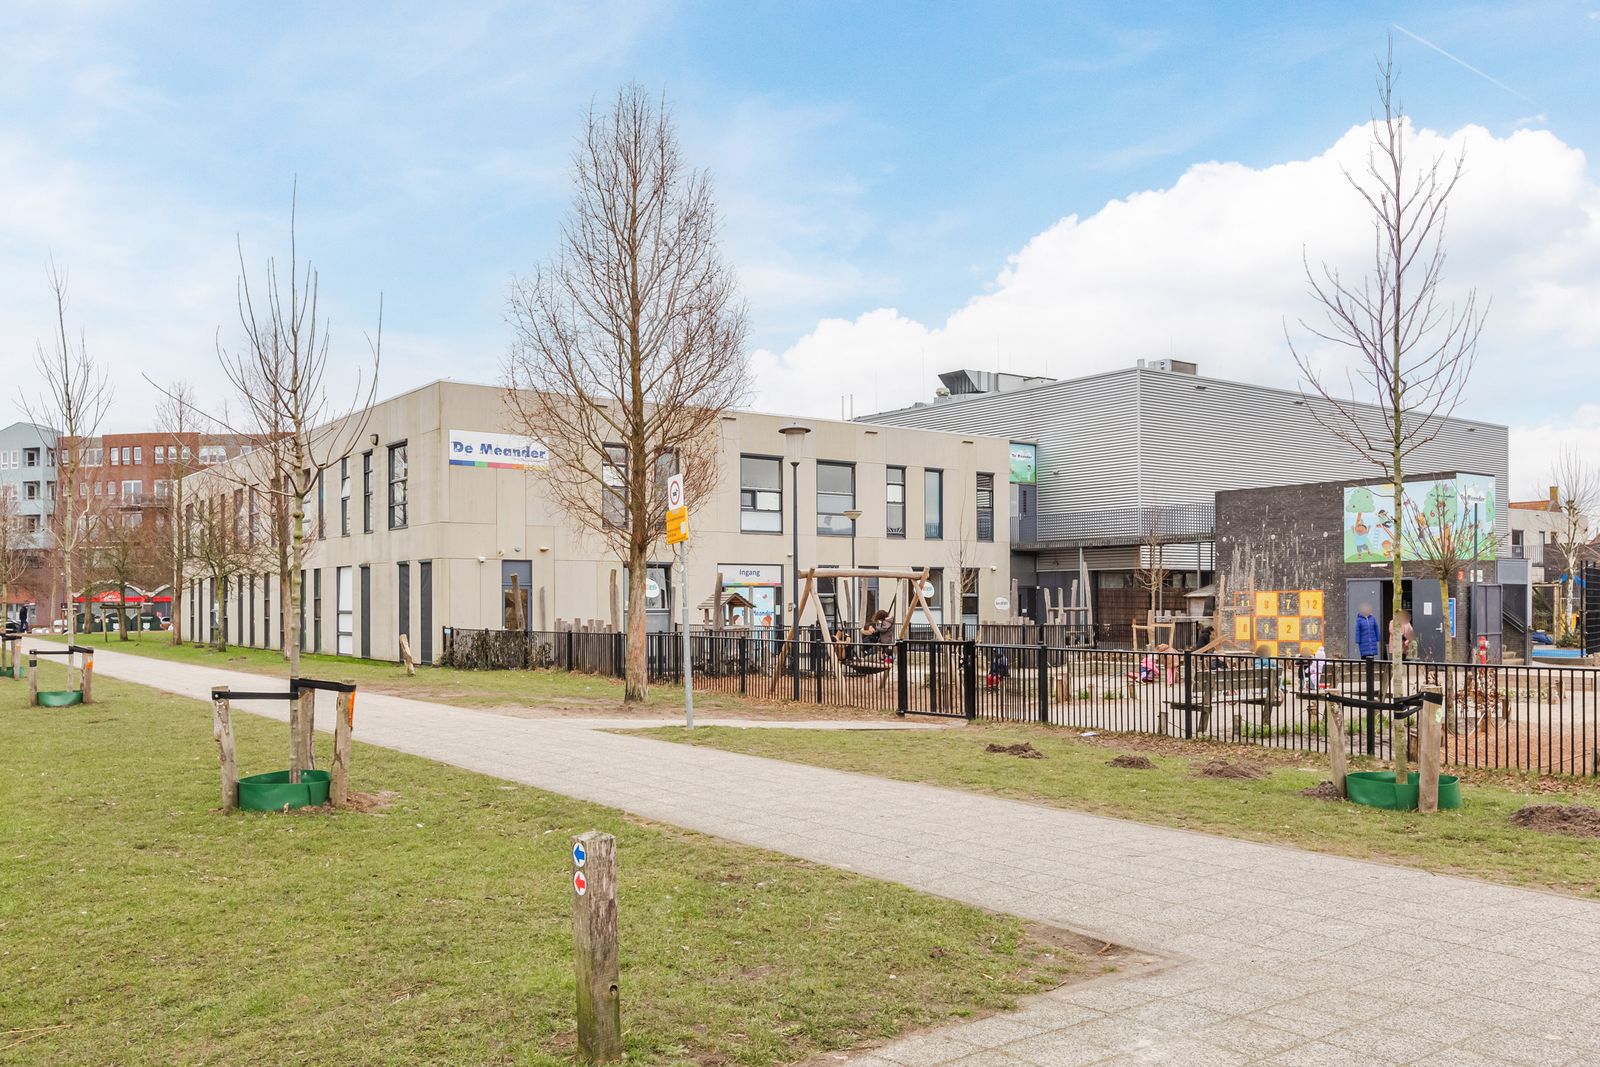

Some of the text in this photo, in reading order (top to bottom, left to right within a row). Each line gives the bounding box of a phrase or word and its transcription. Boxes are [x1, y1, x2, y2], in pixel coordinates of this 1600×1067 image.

[452, 441, 546, 458] De Meander
[739, 569, 761, 577] Ingang
[1285, 599, 1292, 610] 7
[1306, 600, 1318, 610] 12
[1264, 623, 1270, 634] 3
[1286, 624, 1292, 634] 2
[1306, 623, 1318, 635] 10
